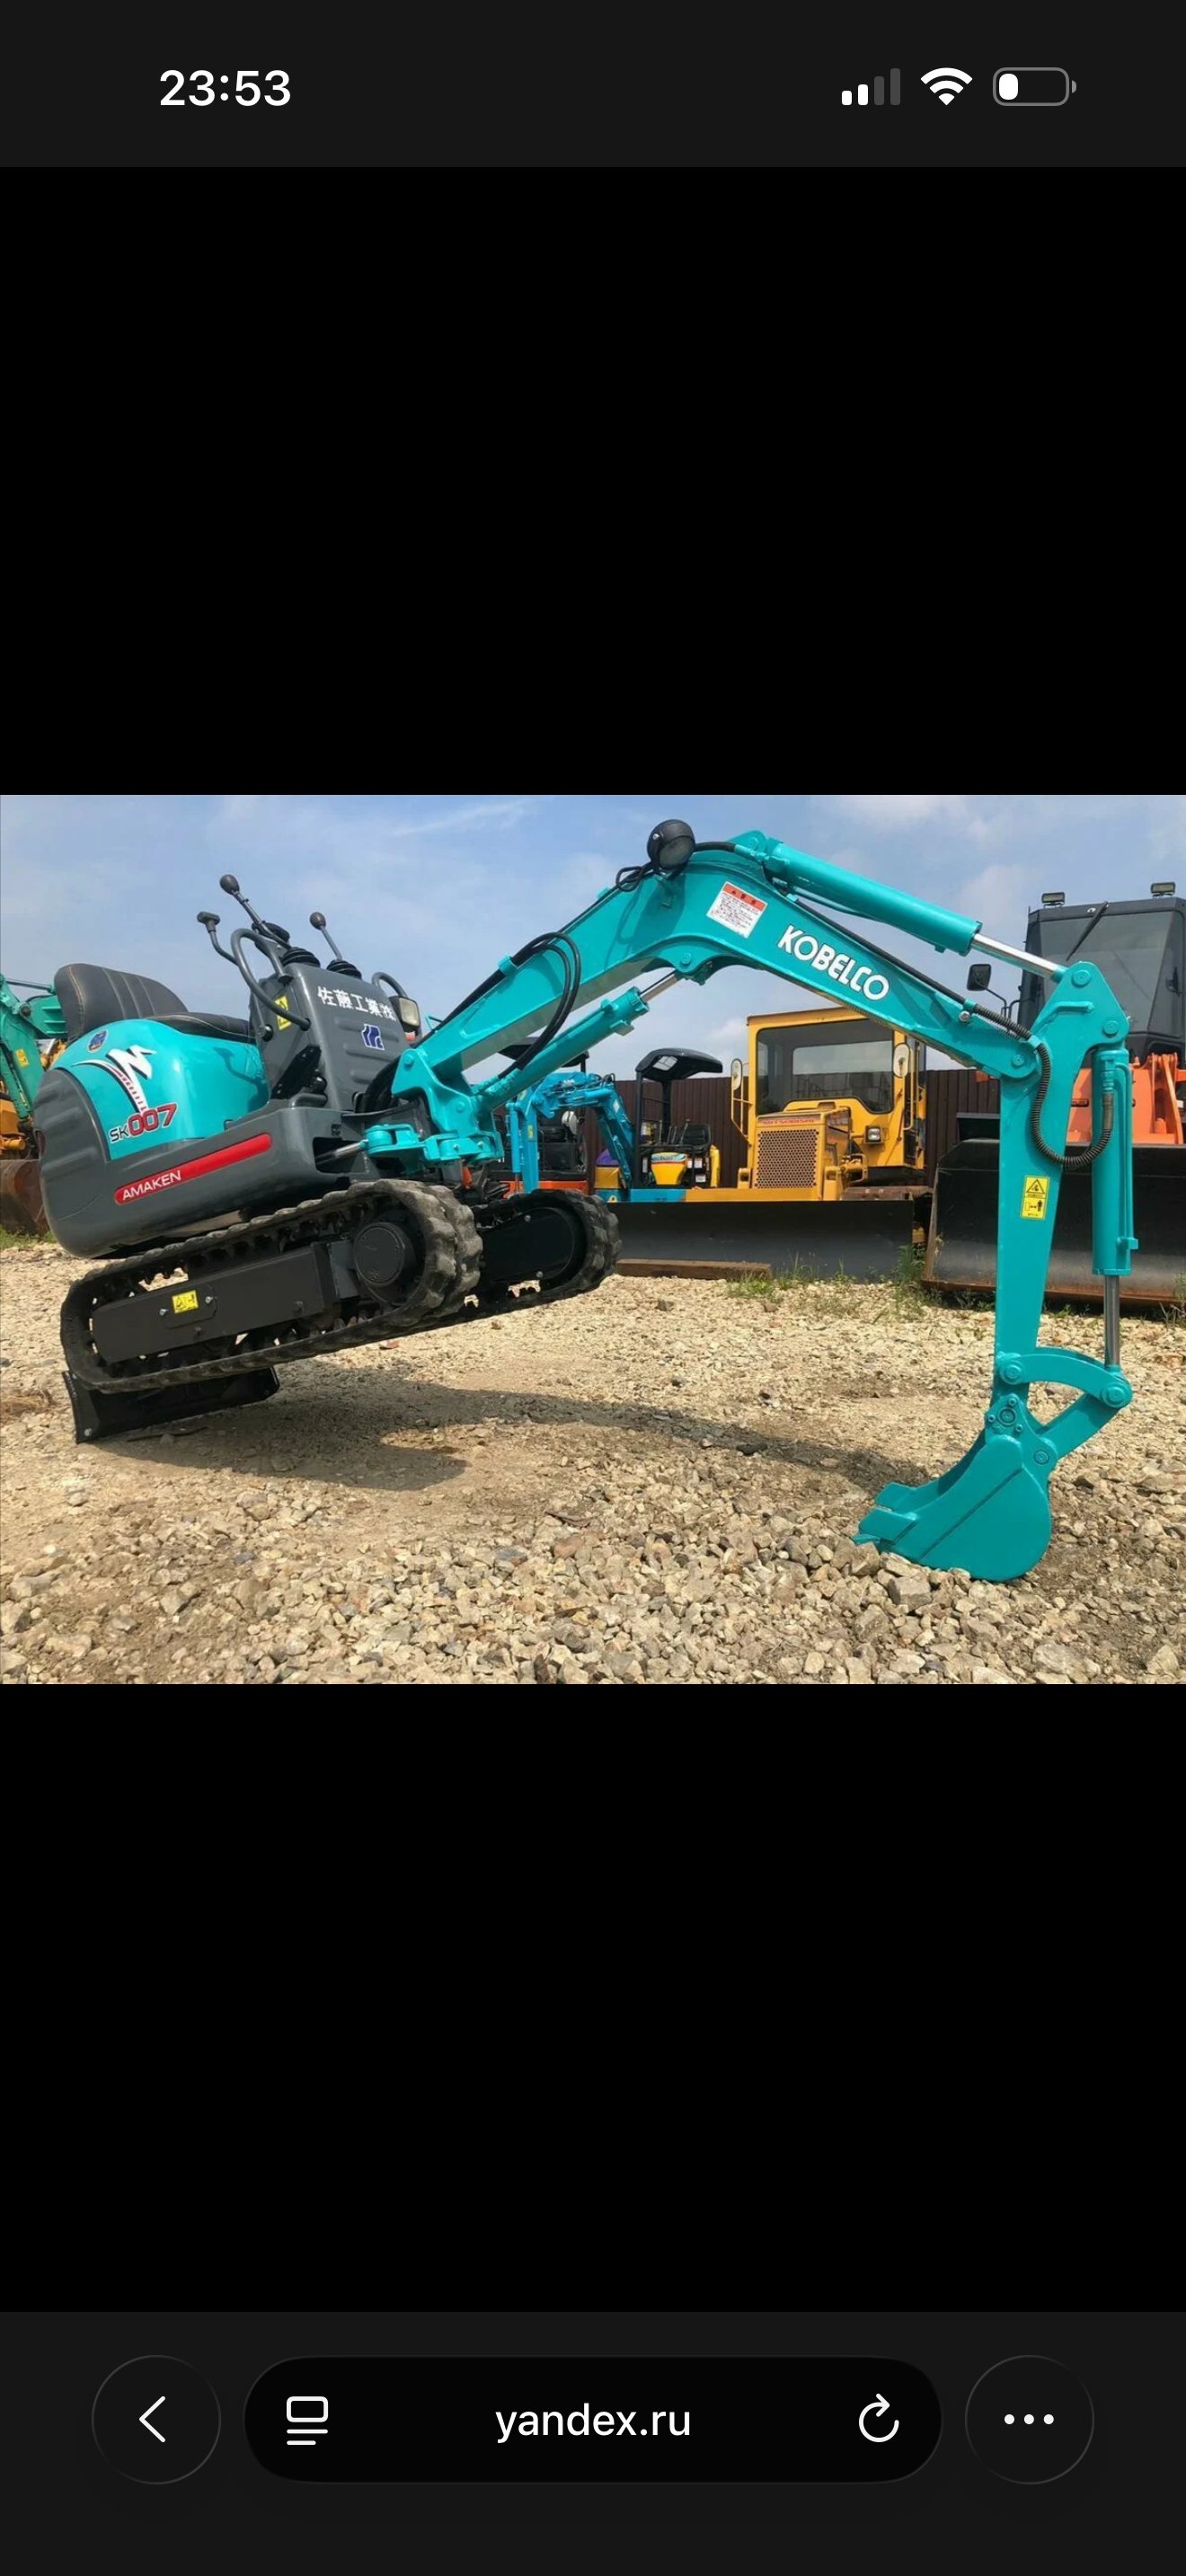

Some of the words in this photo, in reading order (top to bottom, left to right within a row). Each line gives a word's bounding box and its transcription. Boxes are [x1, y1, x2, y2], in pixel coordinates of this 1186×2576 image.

[777, 925, 890, 1001] KOBELCO
[109, 1103, 178, 1142] SK007
[122, 1169, 181, 1201] AMAKEN
